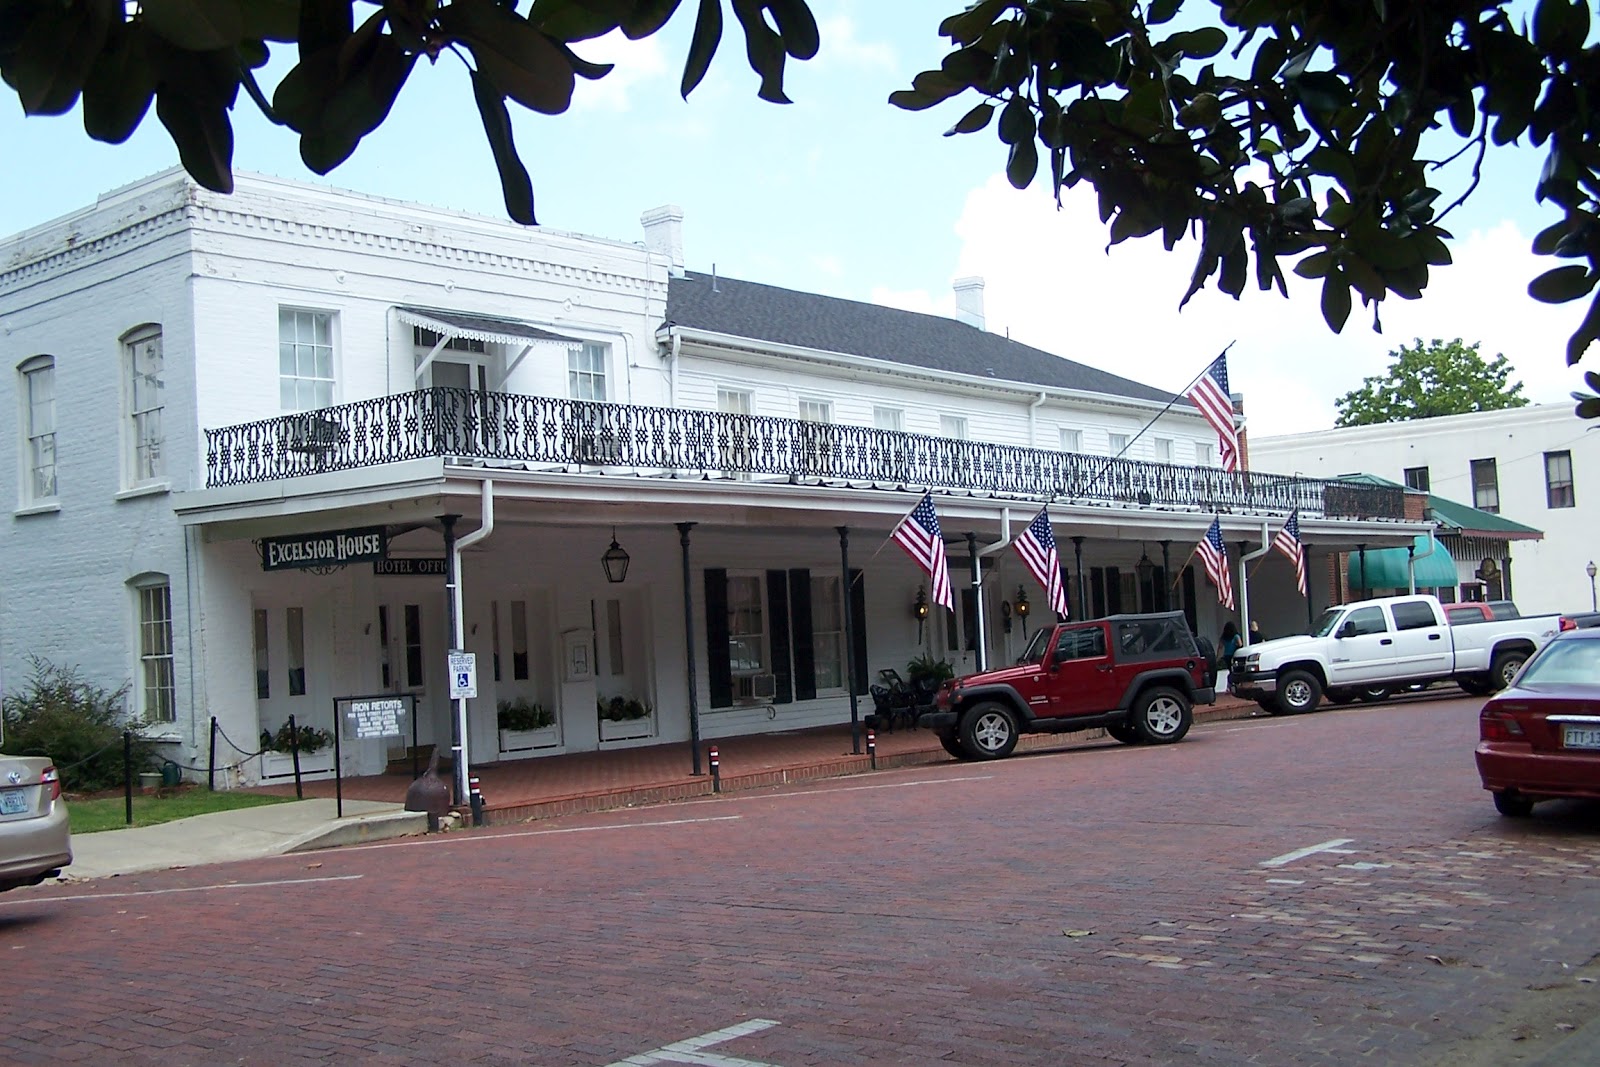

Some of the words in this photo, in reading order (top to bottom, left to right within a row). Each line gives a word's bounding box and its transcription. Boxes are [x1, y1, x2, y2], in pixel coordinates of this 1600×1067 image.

[269, 540, 335, 567] EXCELSIOR
[337, 534, 380, 560] HOUSE
[377, 560, 412, 573] HOTEL
[419, 560, 447, 572] OFFI
[450, 656, 474, 665] RESERVED
[453, 665, 472, 673] PARKING
[352, 702, 370, 712] IRON
[371, 700, 403, 710] RETORTS
